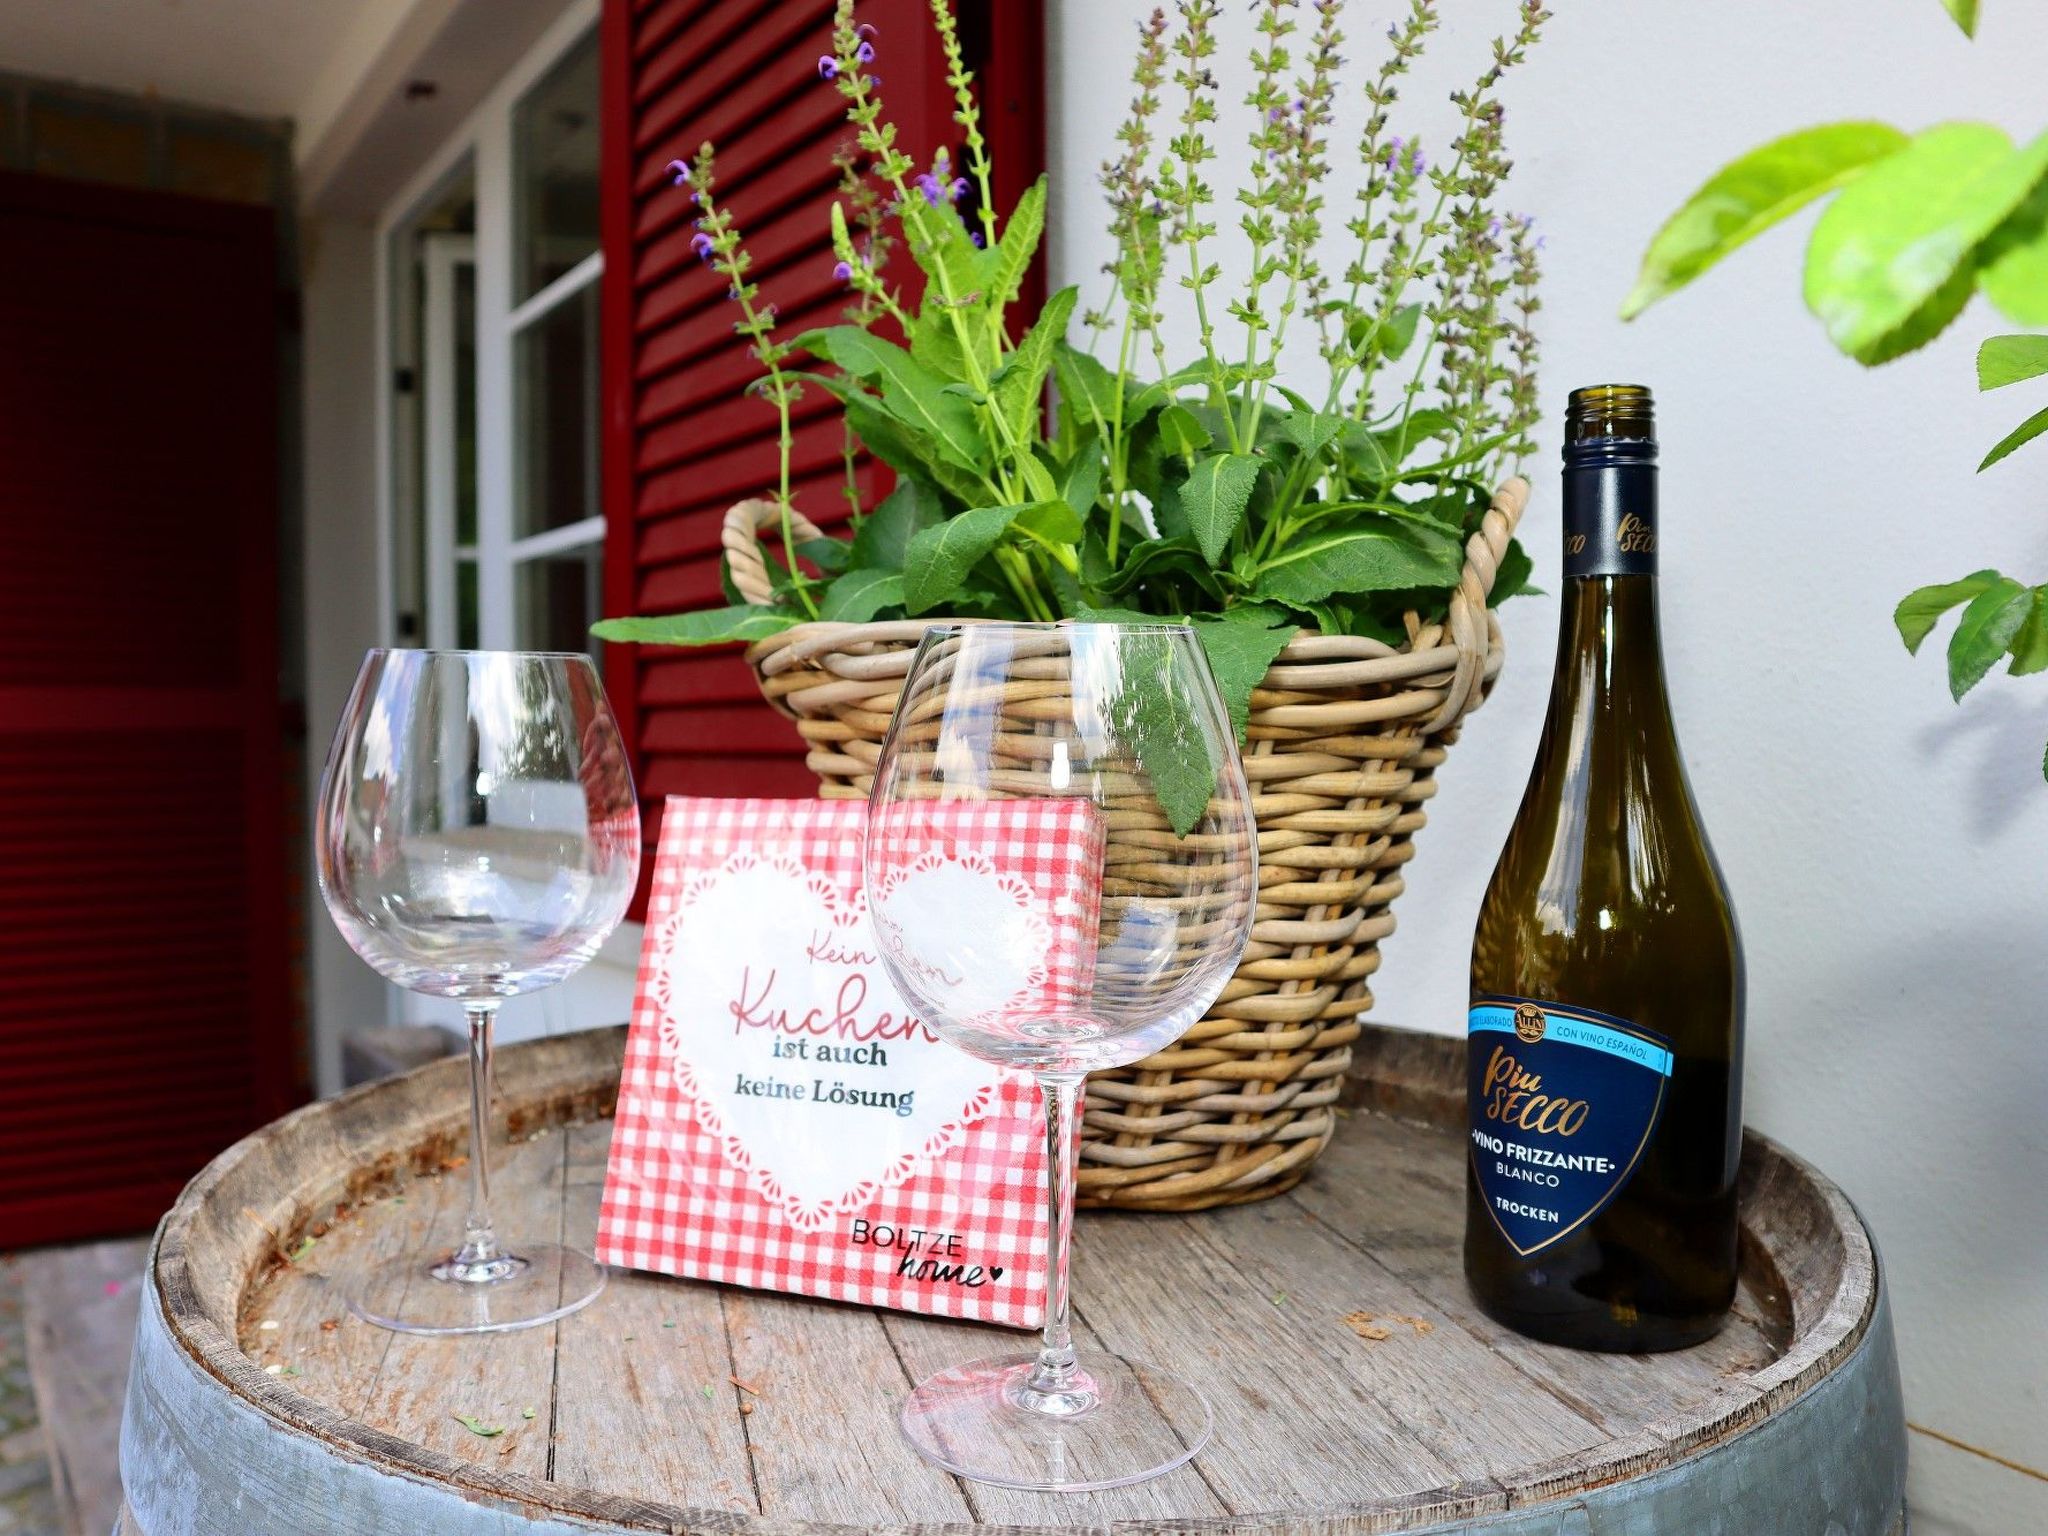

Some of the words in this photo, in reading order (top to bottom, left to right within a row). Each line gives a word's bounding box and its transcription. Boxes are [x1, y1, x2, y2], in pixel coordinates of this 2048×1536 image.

[807, 928, 876, 964] Kein
[729, 966, 939, 1042] Kuchen
[772, 1035, 808, 1060] ist
[816, 1042, 888, 1067] auch
[1556, 1026, 1578, 1038] CON
[1580, 1031, 1605, 1045] VINO
[1606, 1038, 1648, 1060] ESPAÑOL
[734, 1073, 806, 1100] keine
[812, 1079, 914, 1117] Lösung
[1487, 1086, 1590, 1136] SECCO
[1496, 1162, 1560, 1188] BLANCO
[1506, 1142, 1609, 1174] FRIZZANTE
[1496, 1196, 1559, 1224] TROCKEN
[852, 1219, 963, 1257] BOLTZE
[897, 1241, 987, 1287] home
